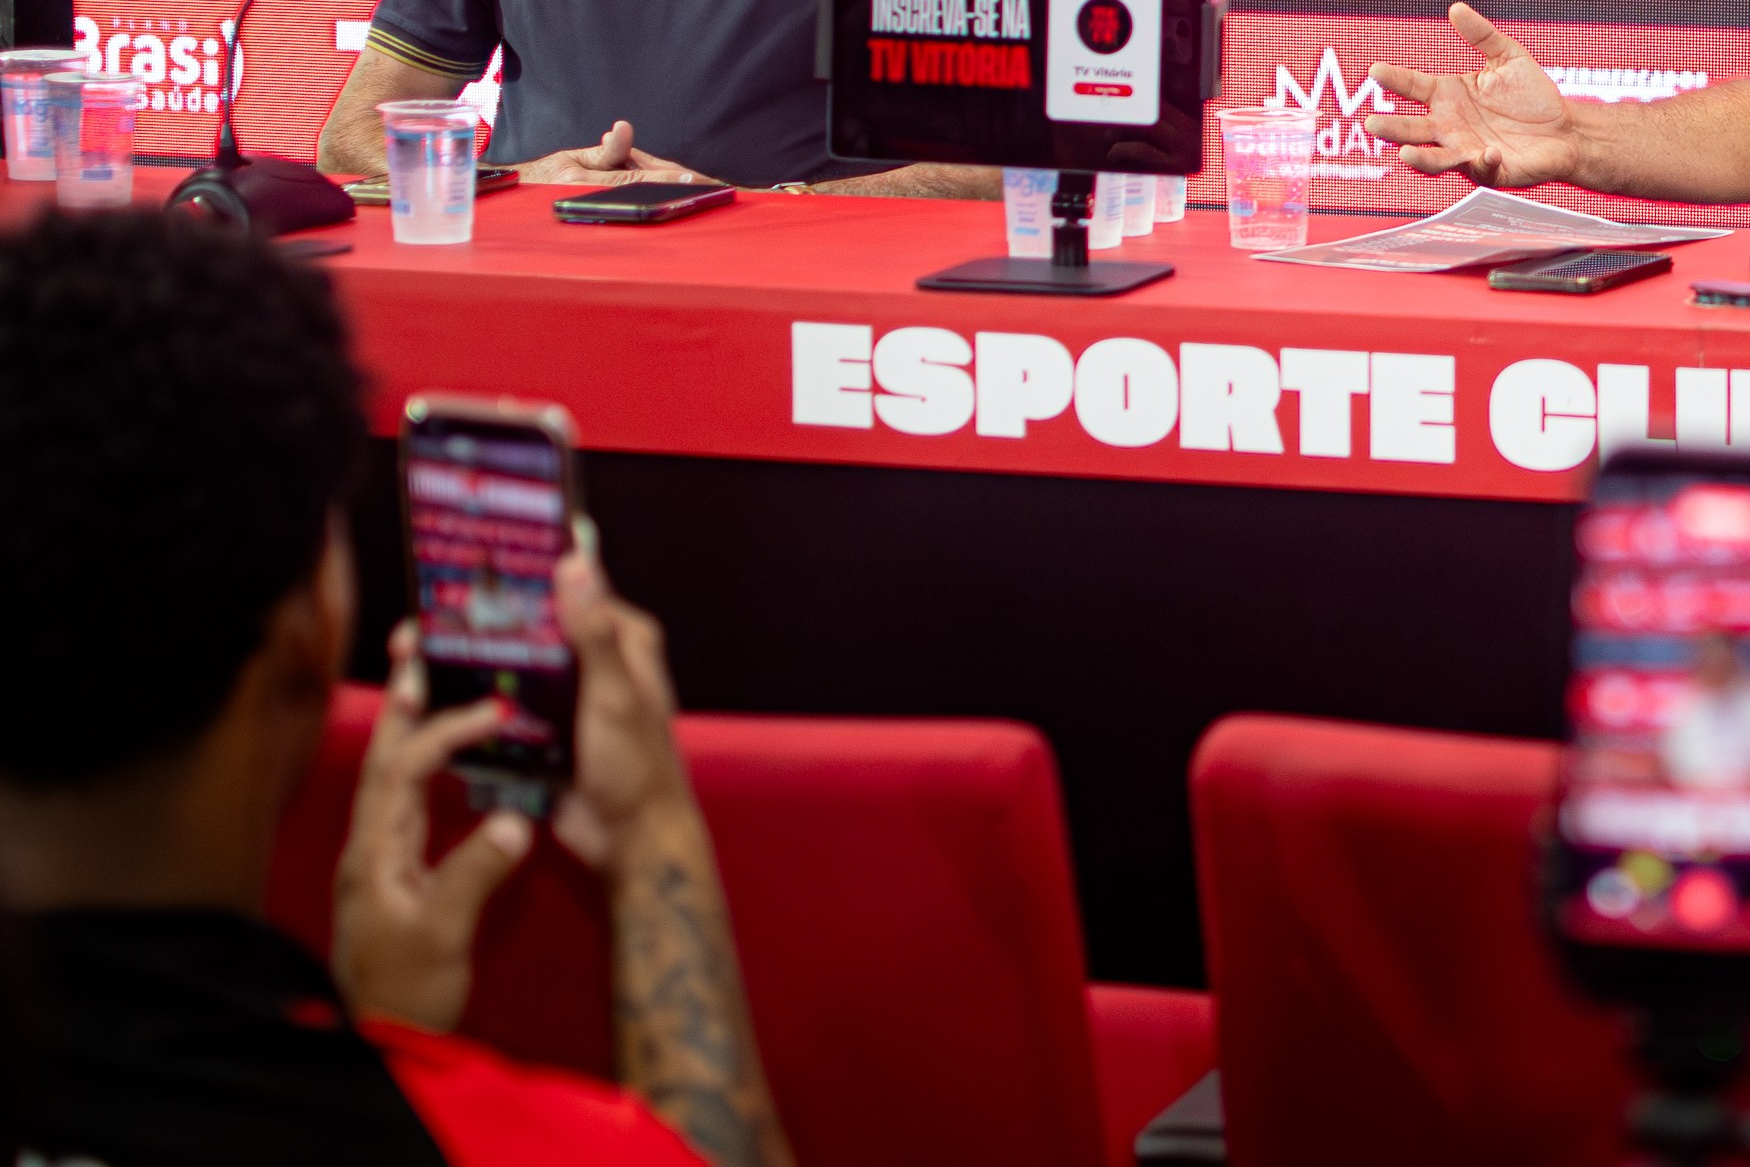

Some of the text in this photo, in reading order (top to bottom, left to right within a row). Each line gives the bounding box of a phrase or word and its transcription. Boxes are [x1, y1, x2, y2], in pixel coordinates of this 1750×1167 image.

[867, 37, 1033, 90] TV VITÓRIA
[791, 320, 1456, 465] ESPORTE
